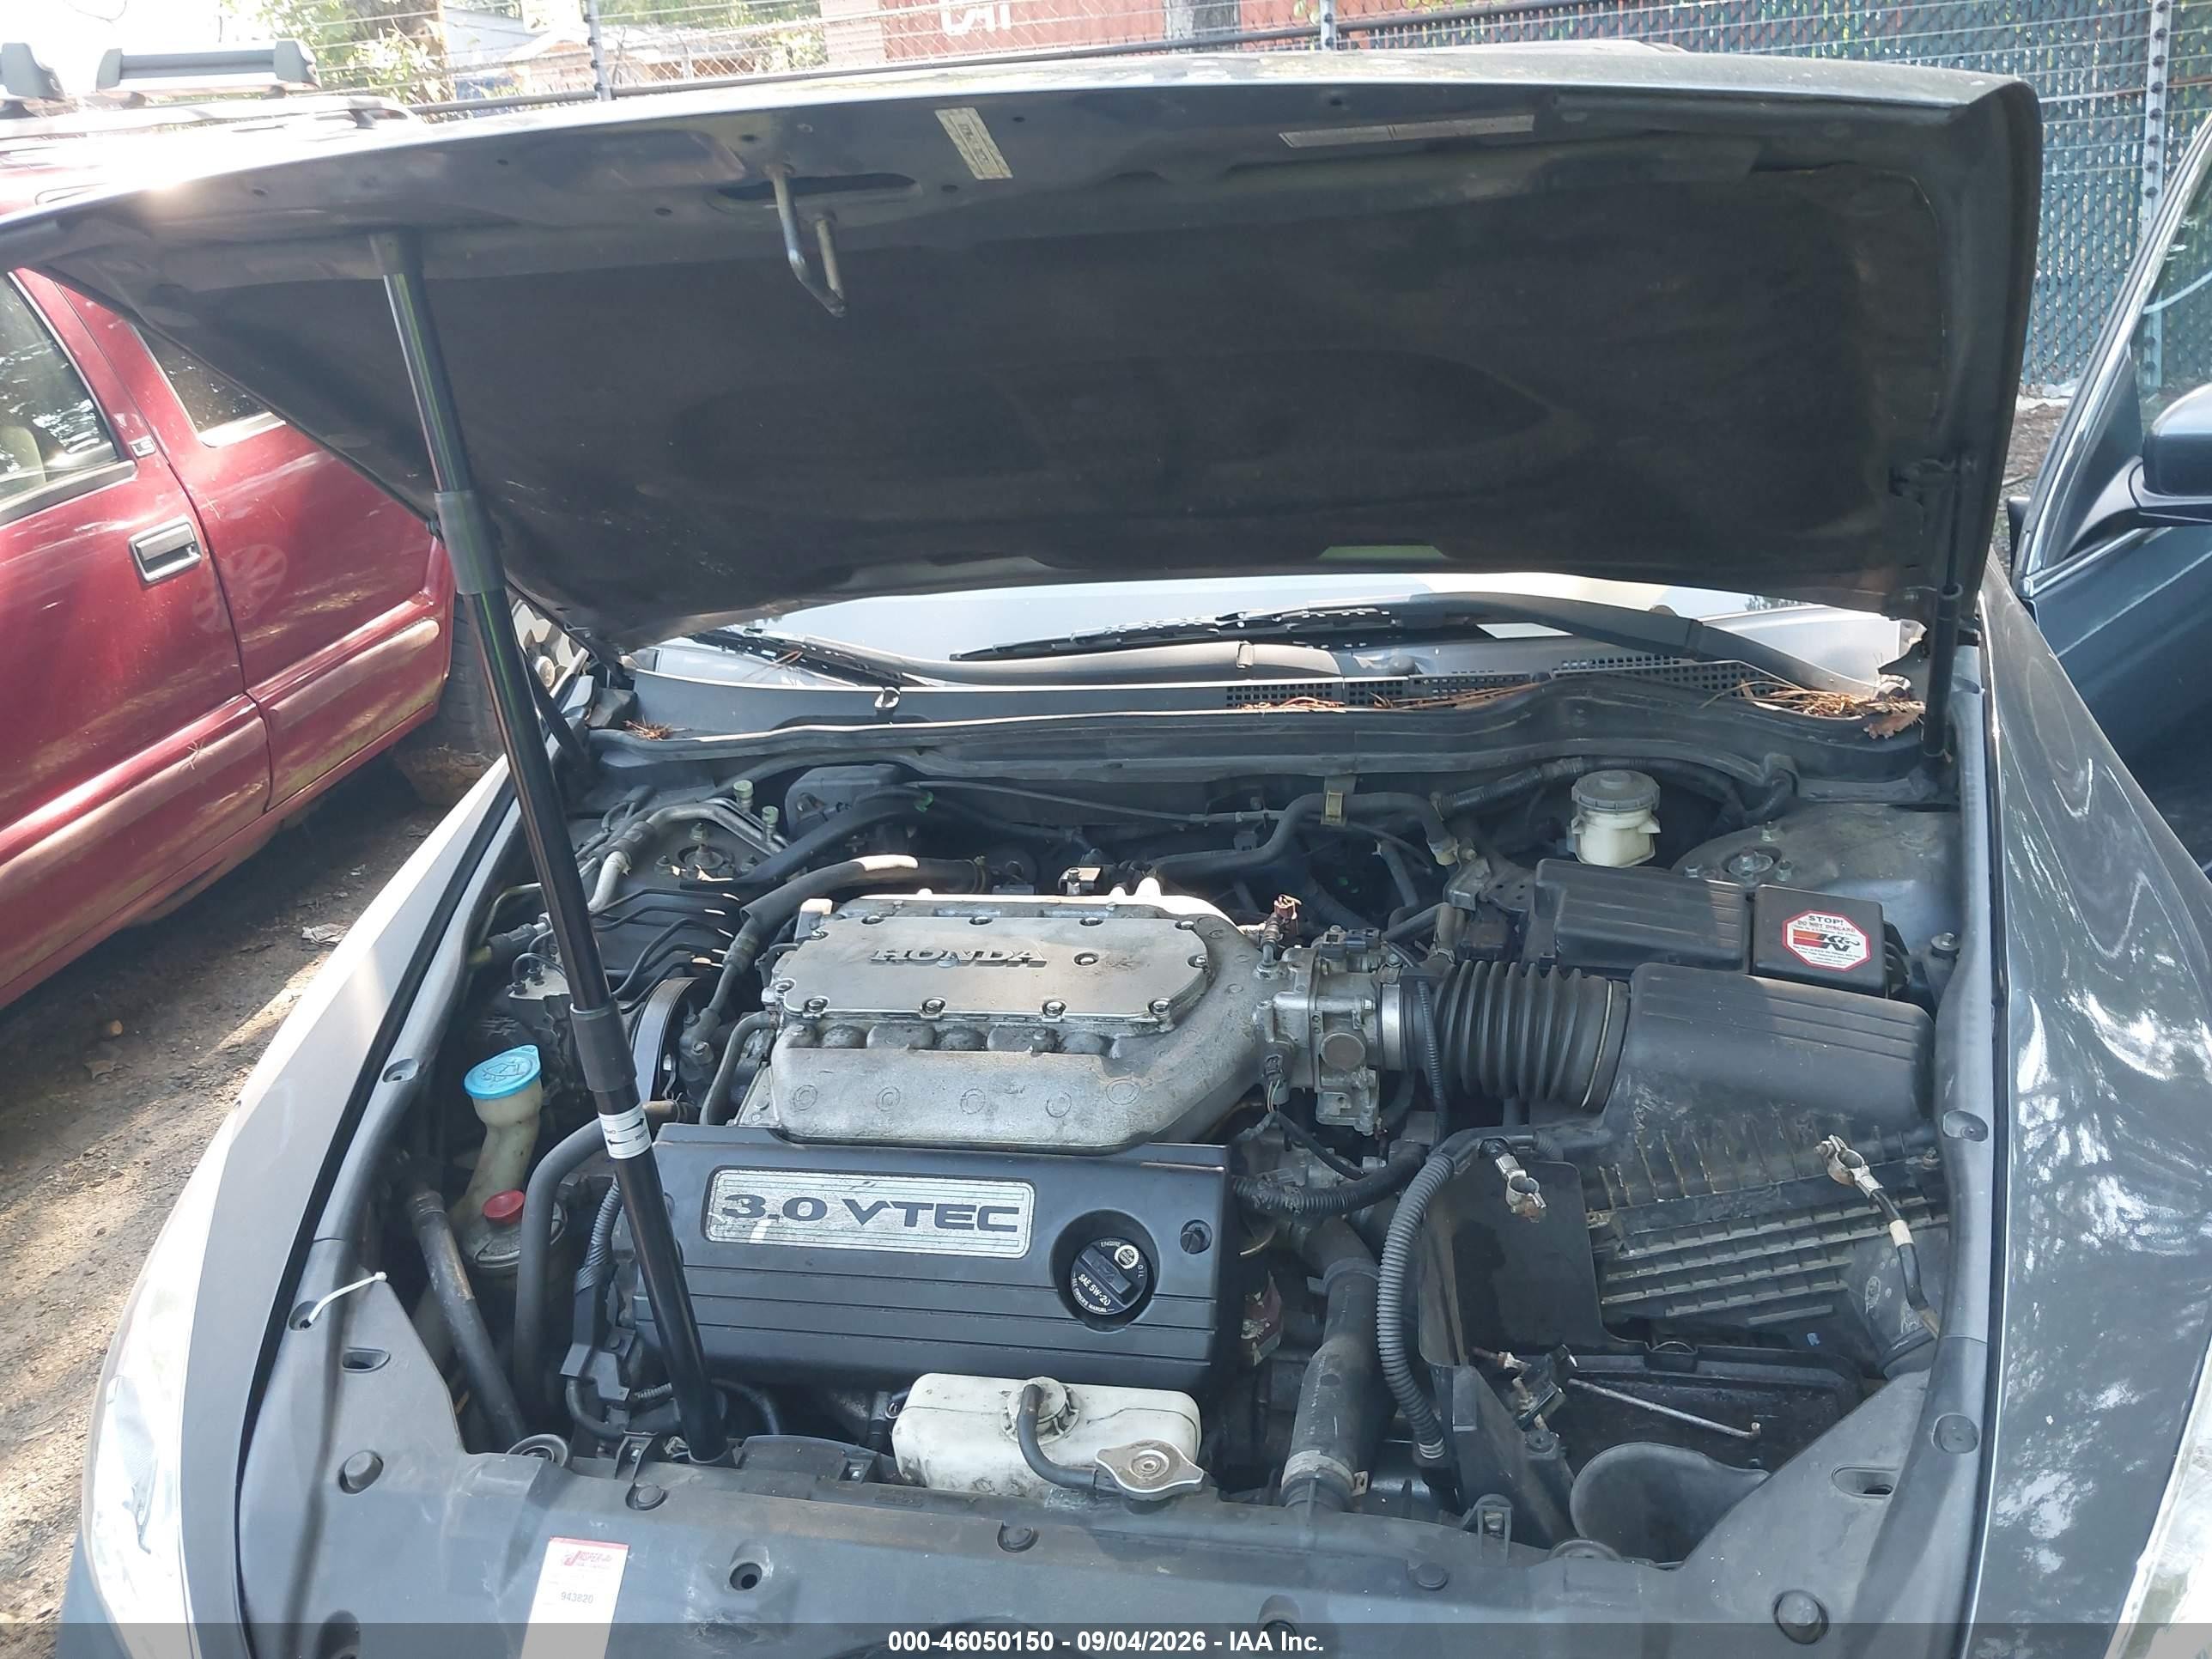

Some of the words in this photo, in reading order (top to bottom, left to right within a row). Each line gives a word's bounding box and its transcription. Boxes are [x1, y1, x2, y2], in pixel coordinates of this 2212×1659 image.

[131, 439, 156, 457] LS
[1808, 915, 1844, 926] STOP!
[871, 947, 1049, 968] HONDA
[721, 1194, 828, 1224] 3.0
[841, 1199, 1020, 1233] VTEC
[1078, 1273, 1091, 1288] SAE
[1089, 1284, 1112, 1307] 5W-20
[560, 1591, 594, 1604] 943820
